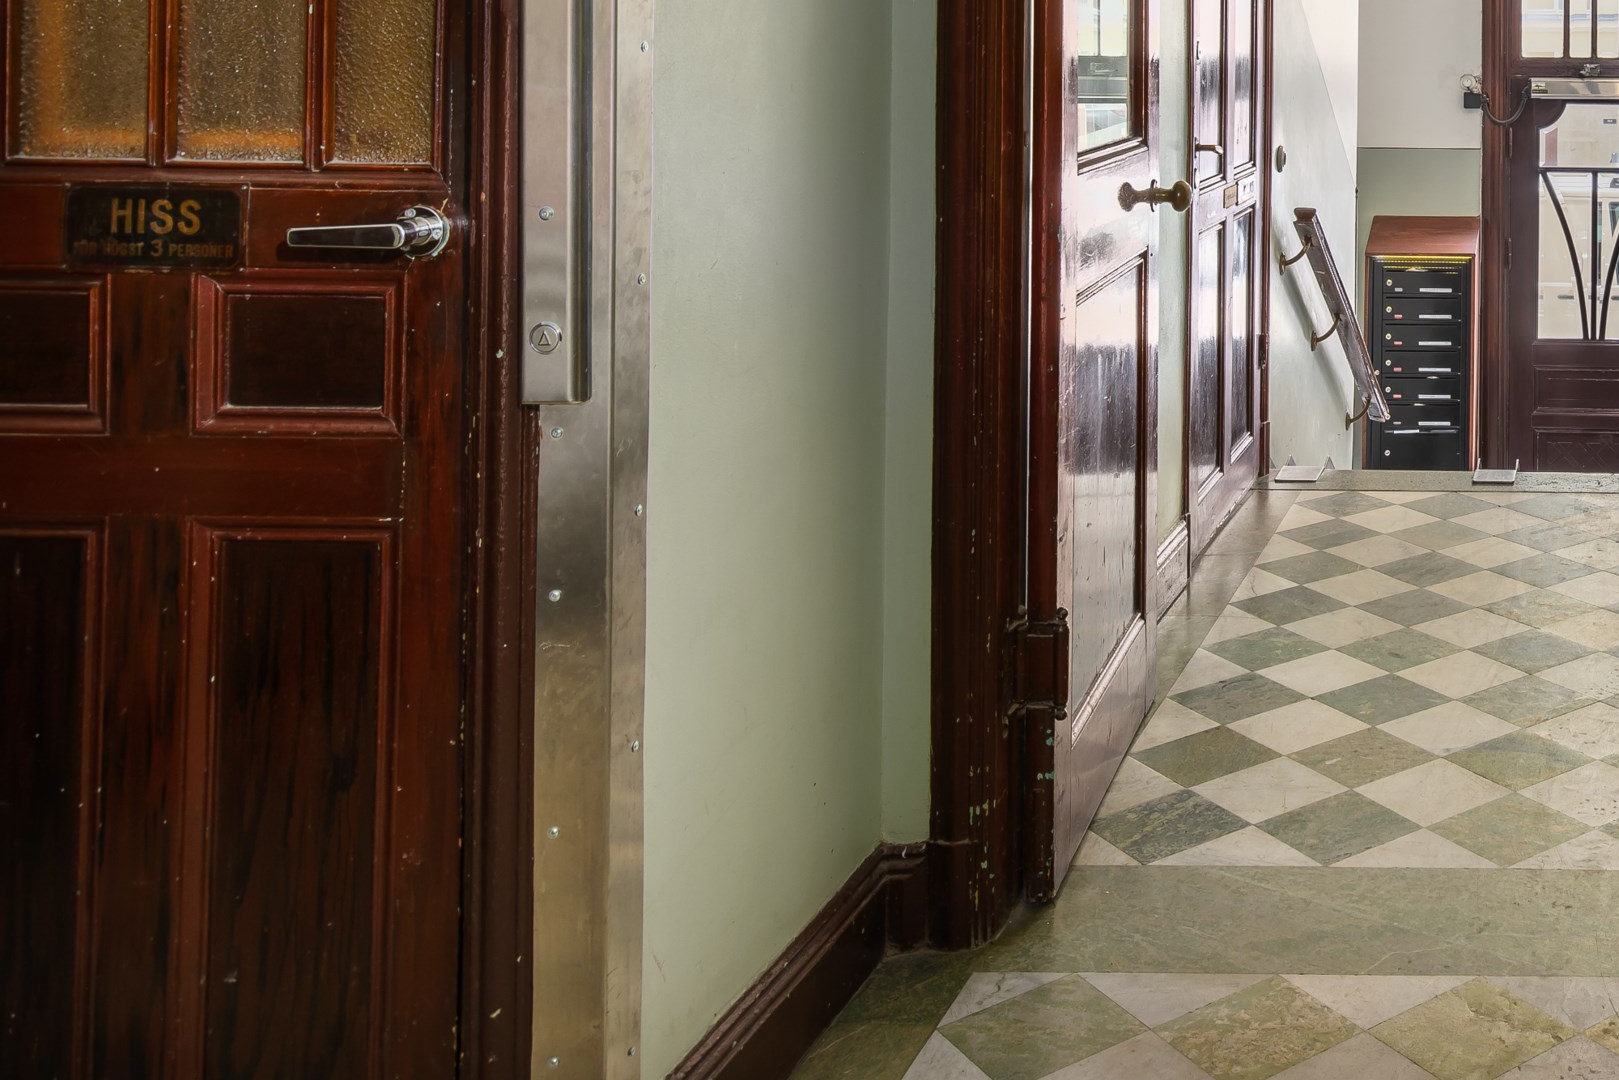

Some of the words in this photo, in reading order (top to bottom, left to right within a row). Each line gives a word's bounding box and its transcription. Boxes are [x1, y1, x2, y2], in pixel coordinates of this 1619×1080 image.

[110, 198, 201, 236] HISS
[150, 239, 164, 257] 3
[168, 242, 234, 258] PERSONER
